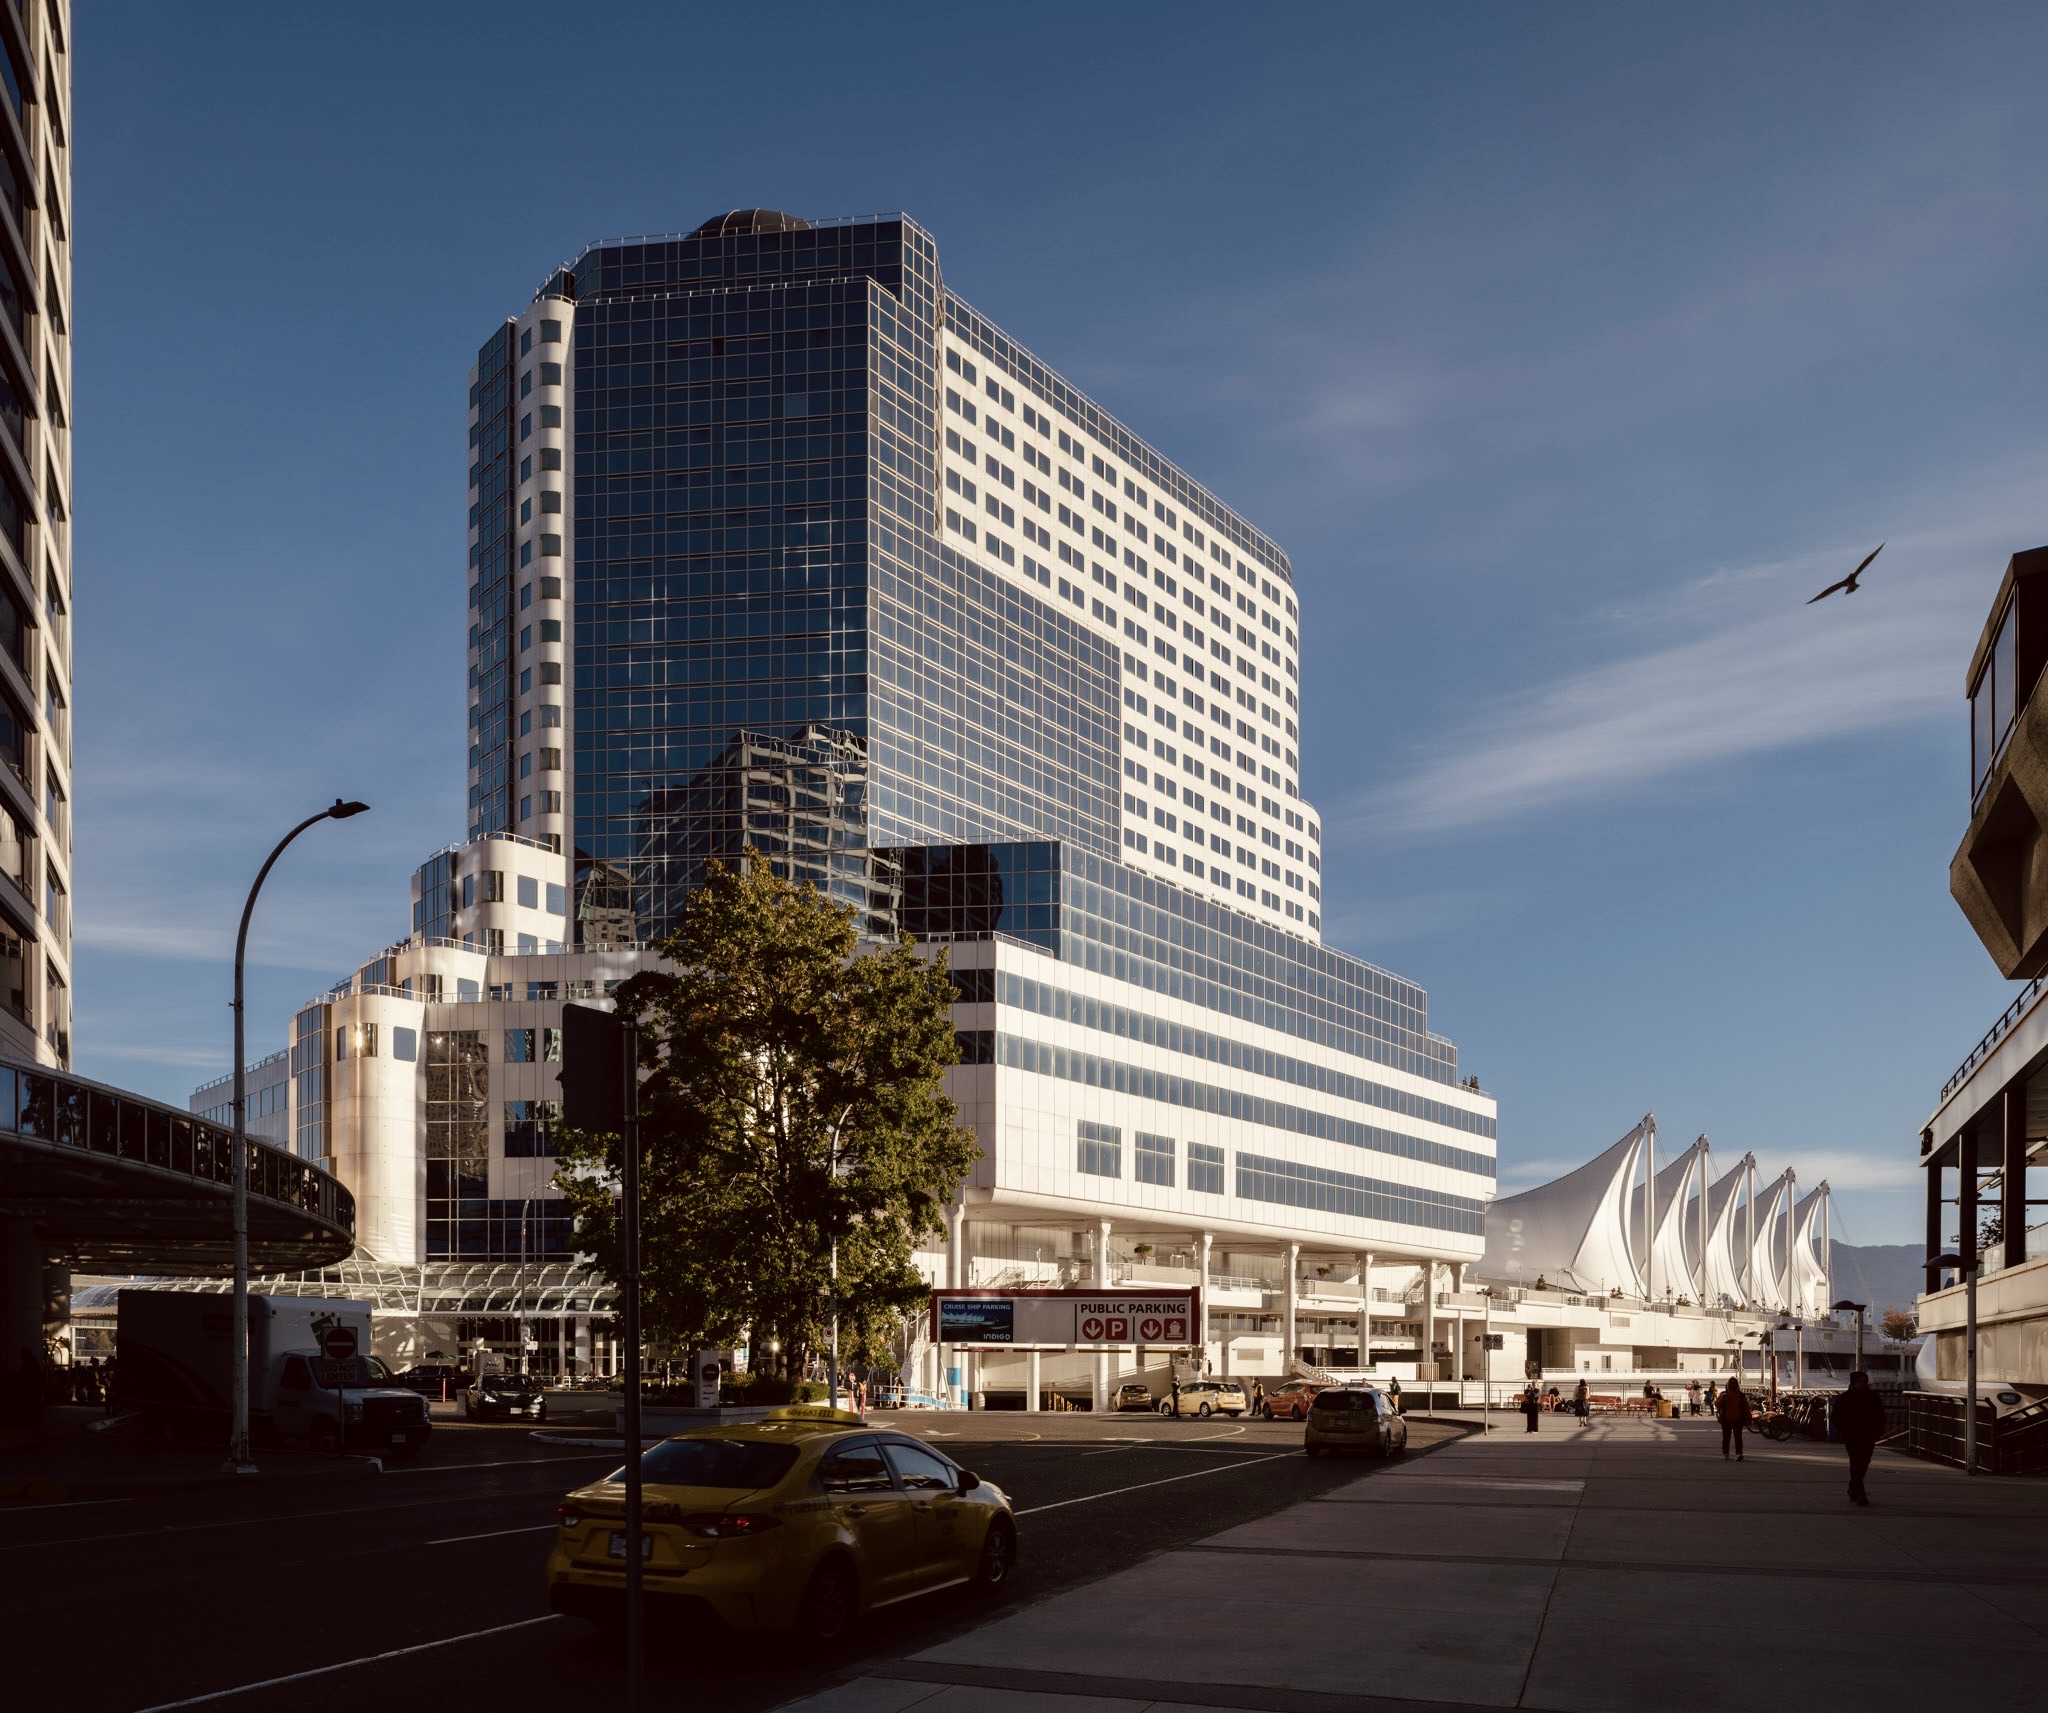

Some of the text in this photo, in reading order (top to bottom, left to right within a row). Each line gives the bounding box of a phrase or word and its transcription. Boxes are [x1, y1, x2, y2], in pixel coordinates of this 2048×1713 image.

[1080, 1303, 1186, 1314] PUBLIC PARKING
[324, 1364, 356, 1372] DO NOT
